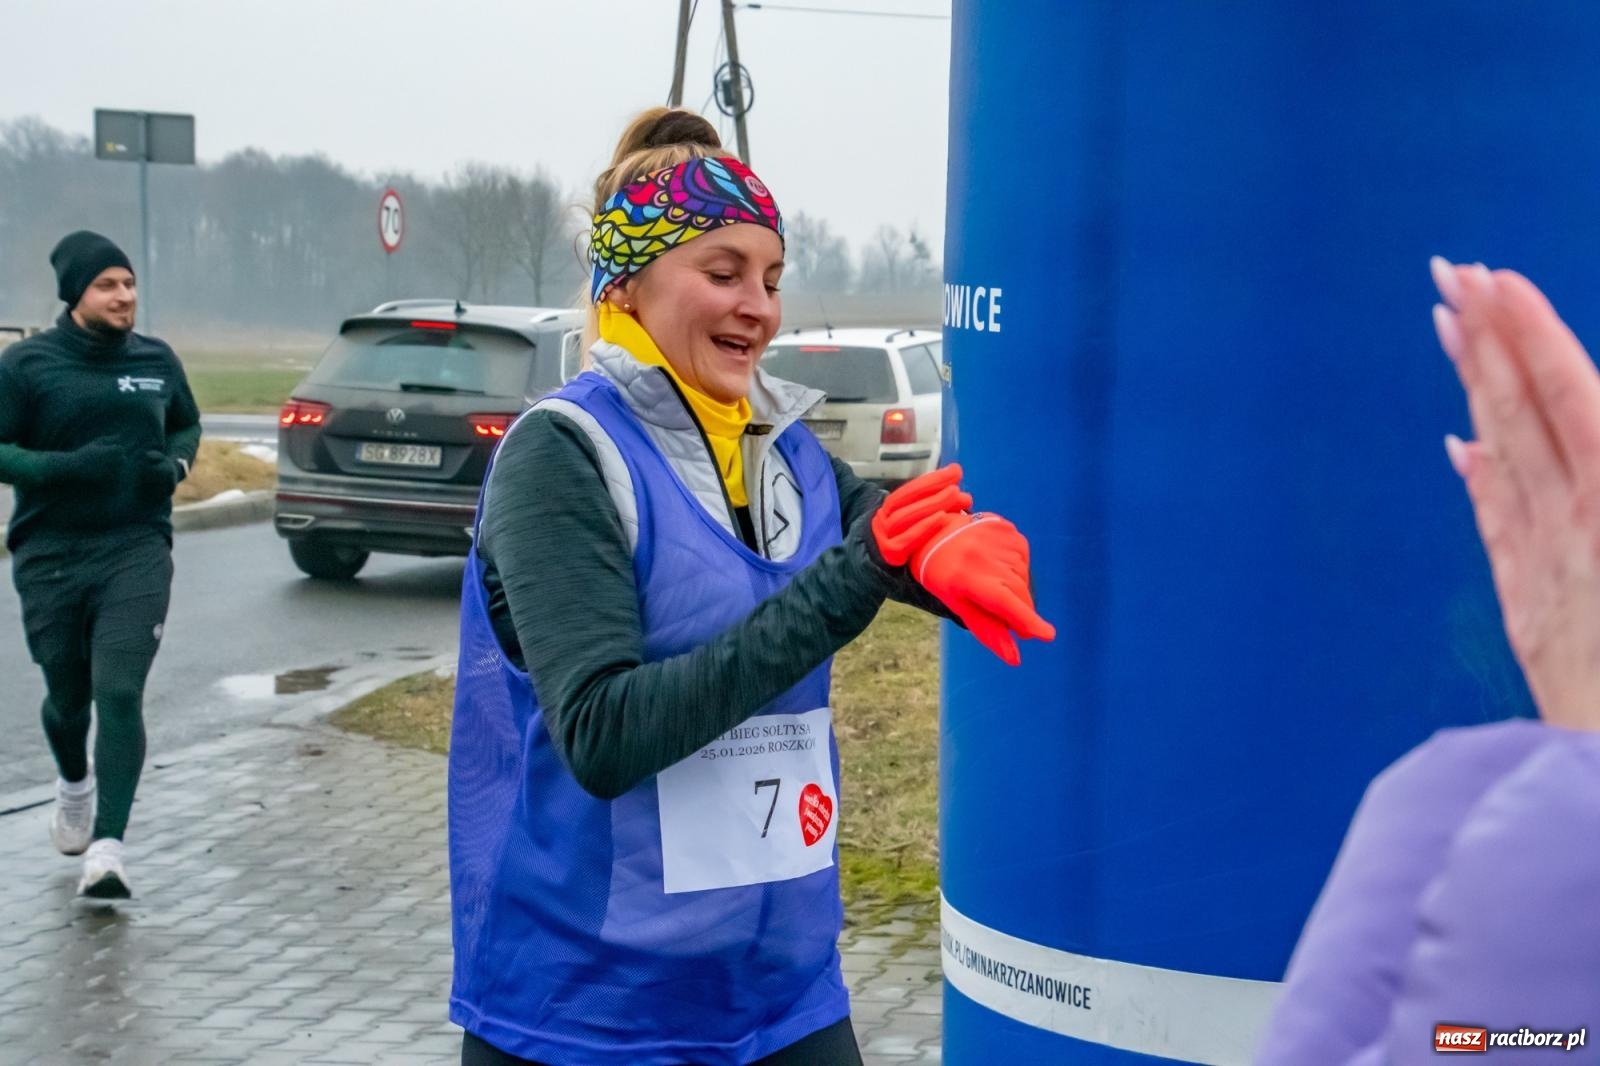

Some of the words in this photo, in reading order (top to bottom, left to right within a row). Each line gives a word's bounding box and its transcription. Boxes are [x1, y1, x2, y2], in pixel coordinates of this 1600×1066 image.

[384, 206, 400, 234] 70
[365, 444, 384, 460] SG
[390, 446, 437, 464] 8928X
[729, 727, 760, 741] BIEG
[701, 744, 765, 760] 25.01.2026
[754, 778, 781, 838] 7
